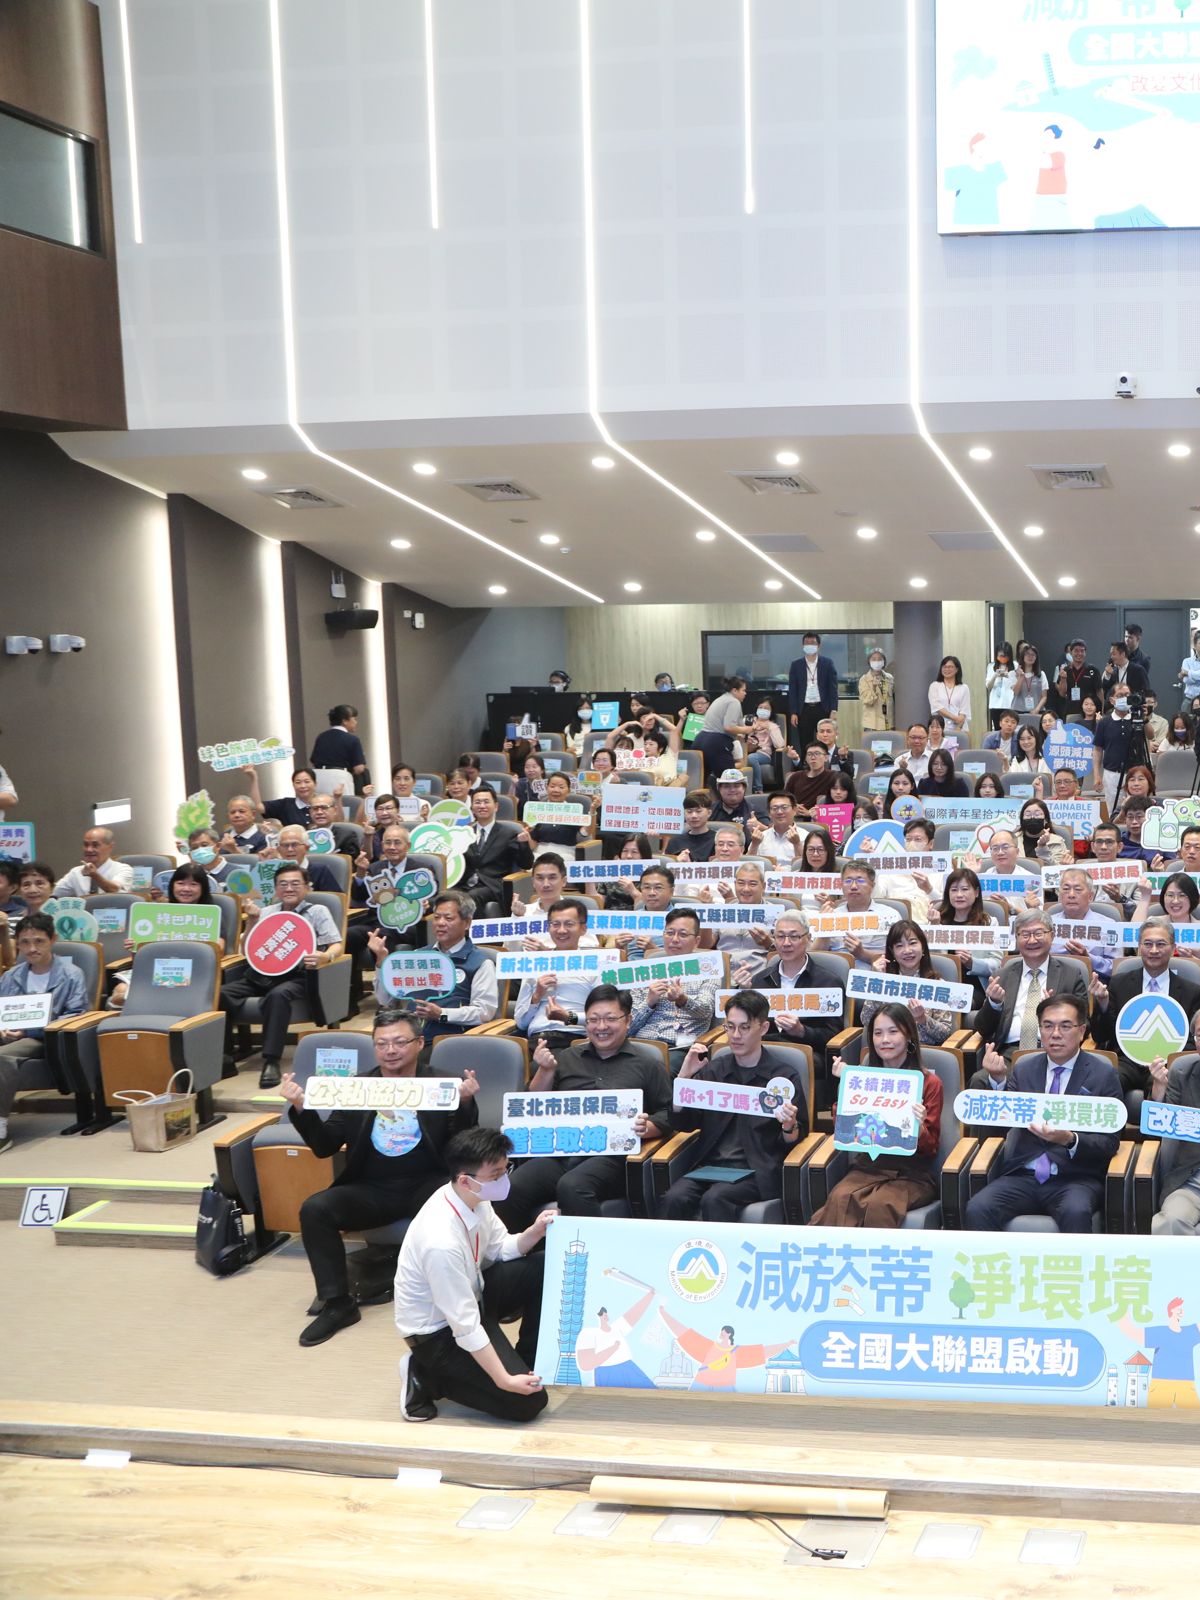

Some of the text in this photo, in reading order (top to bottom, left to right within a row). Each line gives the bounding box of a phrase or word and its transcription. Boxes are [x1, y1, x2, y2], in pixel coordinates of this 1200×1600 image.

[819, 807, 827, 817] 10
[1050, 803, 1093, 811] TAINABLE
[569, 864, 645, 878] 彰化縣環保局
[670, 866, 737, 880] 新竹市環保
[780, 875, 844, 890] 基隆市環保
[394, 902, 408, 913] Go
[697, 908, 766, 924] 江縣環資局
[388, 909, 415, 925] Green
[808, 915, 880, 933] 門縣環保局
[924, 929, 995, 945] 湖縣環保局
[500, 954, 599, 972] 新北市環保局
[601, 958, 702, 986] 桃園市環保局
[850, 974, 952, 1004] 臺南市環保局
[308, 1078, 426, 1108] 公私協力
[848, 1075, 912, 1095] 永續消費
[506, 1095, 619, 1118] 臺北市環保局
[849, 1094, 909, 1110] So Easy
[962, 1094, 1120, 1130] 減菸蒂 淨環境
[735, 1240, 1154, 1325] 減菸蒂 淨環境
[820, 1330, 1080, 1379] 全國大聯盟啟動
